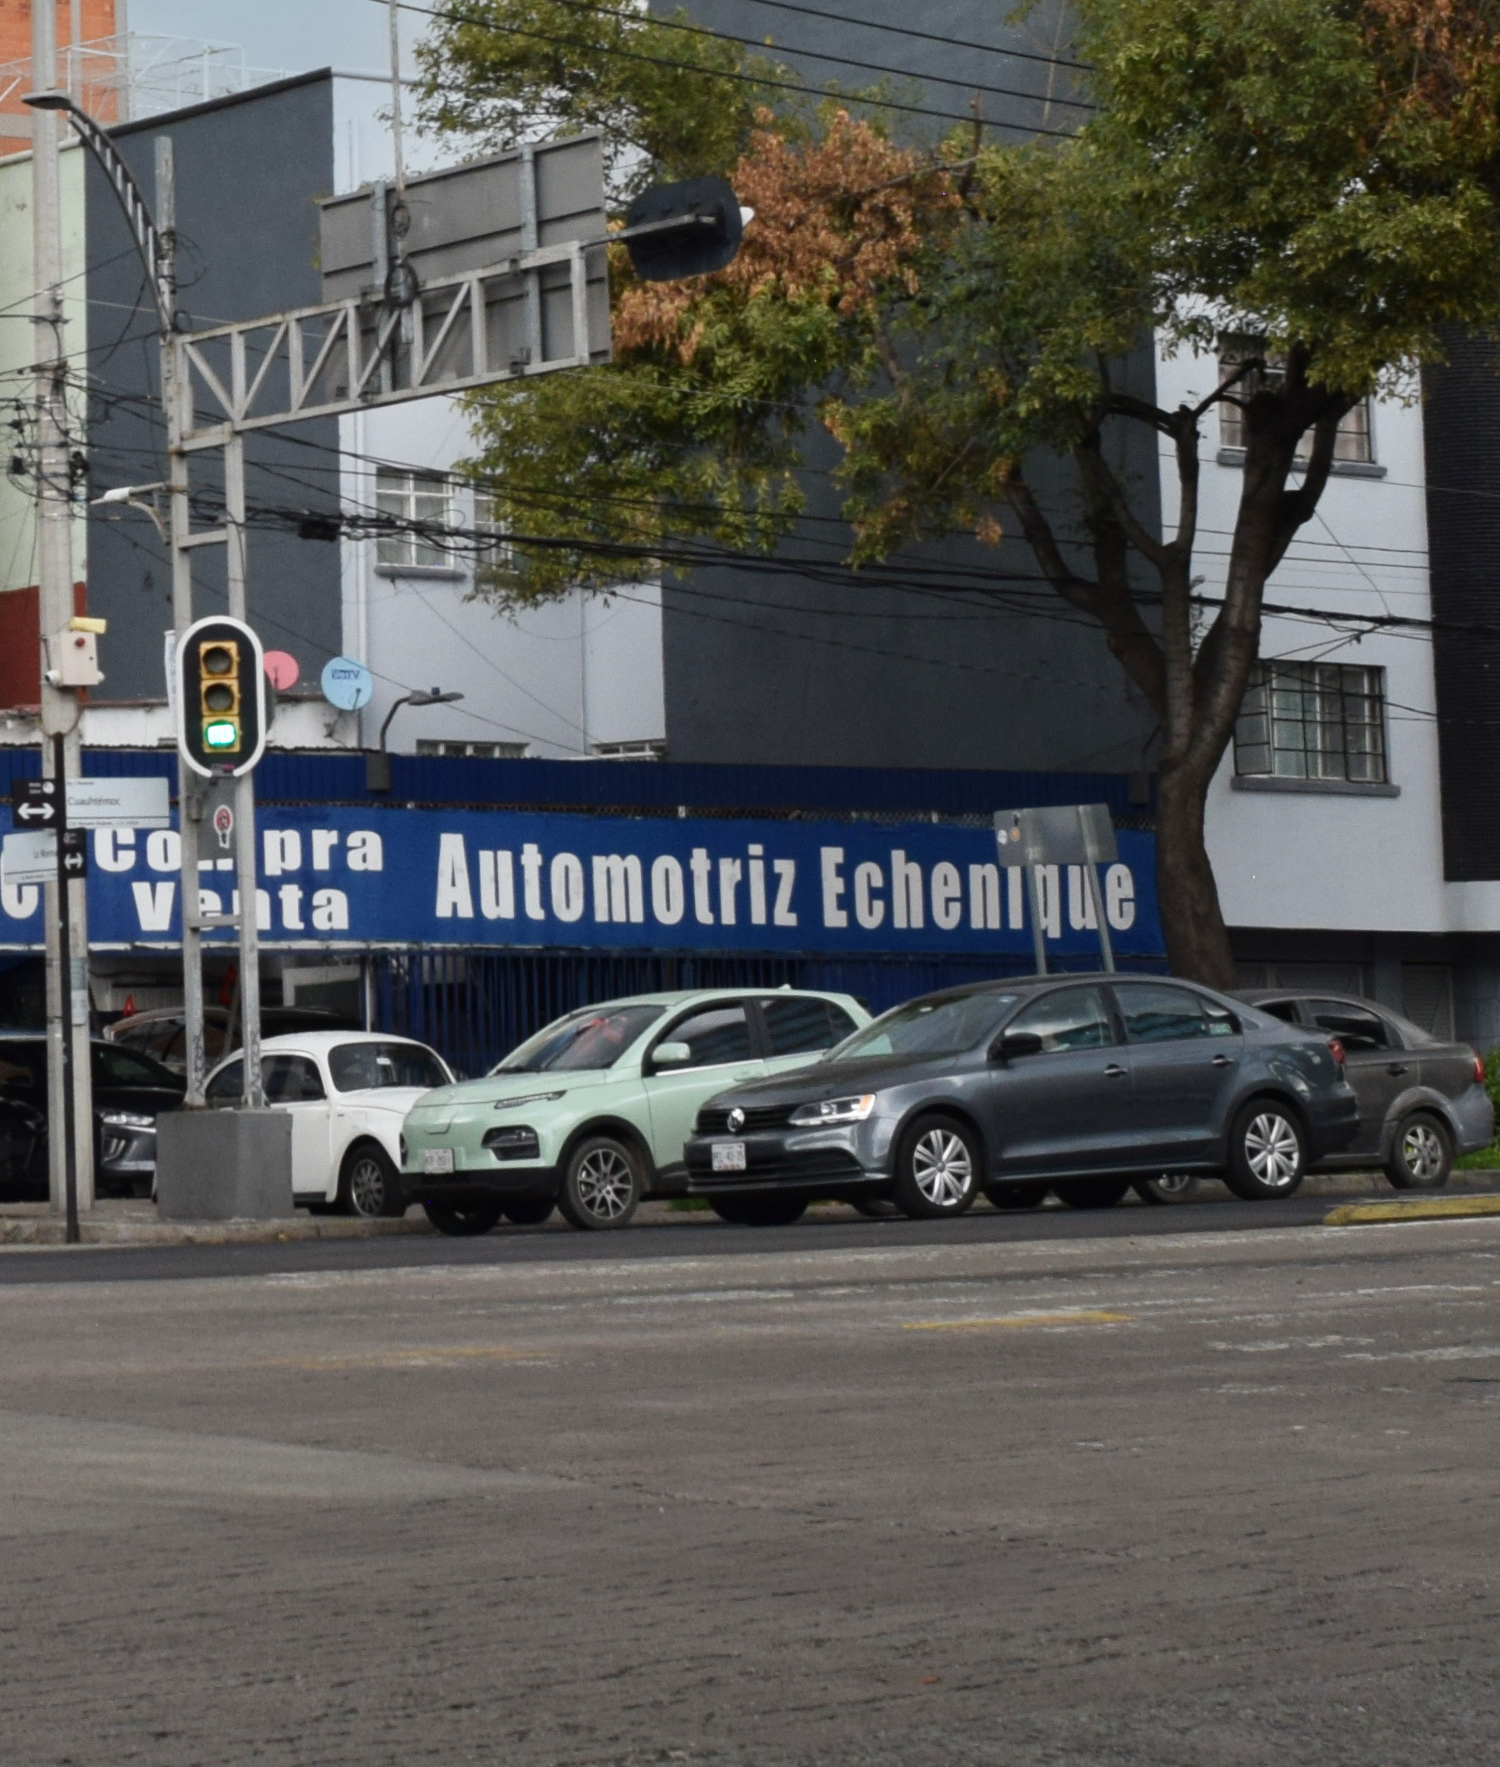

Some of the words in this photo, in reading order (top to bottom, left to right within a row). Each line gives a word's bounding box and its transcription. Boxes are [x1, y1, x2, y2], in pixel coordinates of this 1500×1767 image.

[94, 827, 384, 876] Copra
[434, 833, 799, 929] Automotriz
[821, 846, 1138, 939] Echenique
